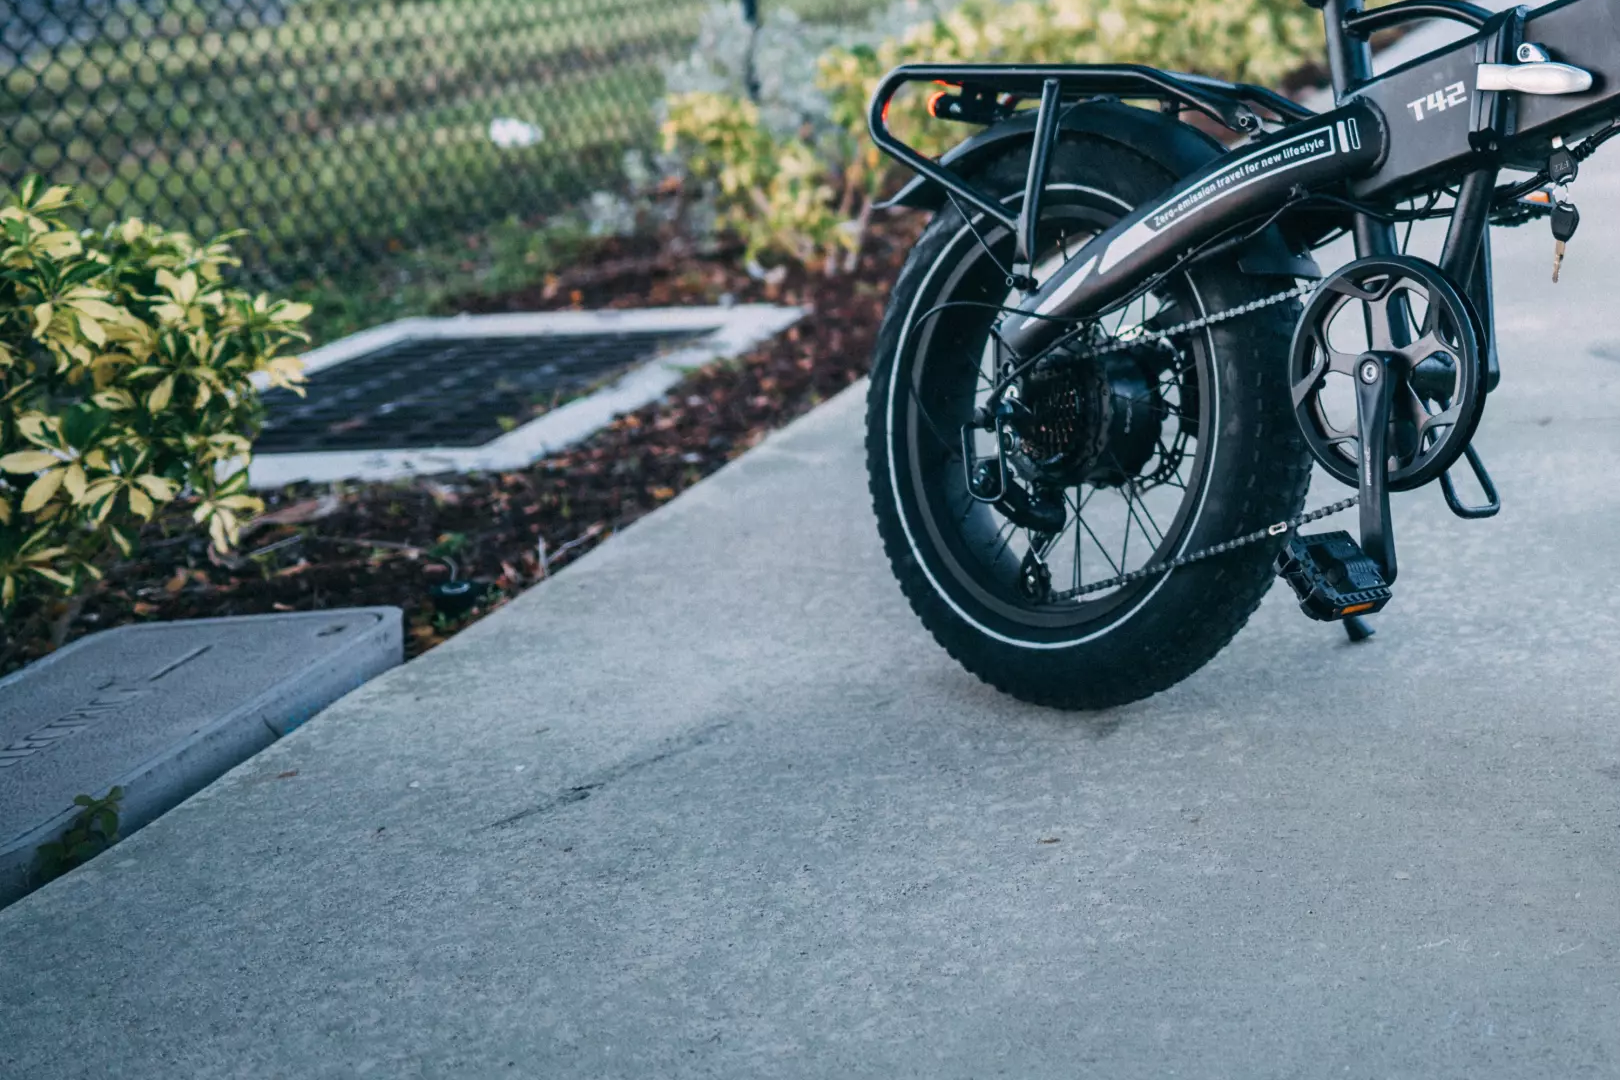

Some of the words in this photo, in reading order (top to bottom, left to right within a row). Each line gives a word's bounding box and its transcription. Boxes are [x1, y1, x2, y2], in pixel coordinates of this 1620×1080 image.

[1406, 80, 1468, 122] T42
[1153, 183, 1217, 228] Zero-emission
[1216, 166, 1246, 188] travel
[1244, 162, 1260, 175] for
[1261, 153, 1282, 168] new
[1282, 137, 1326, 160] lifestyle
